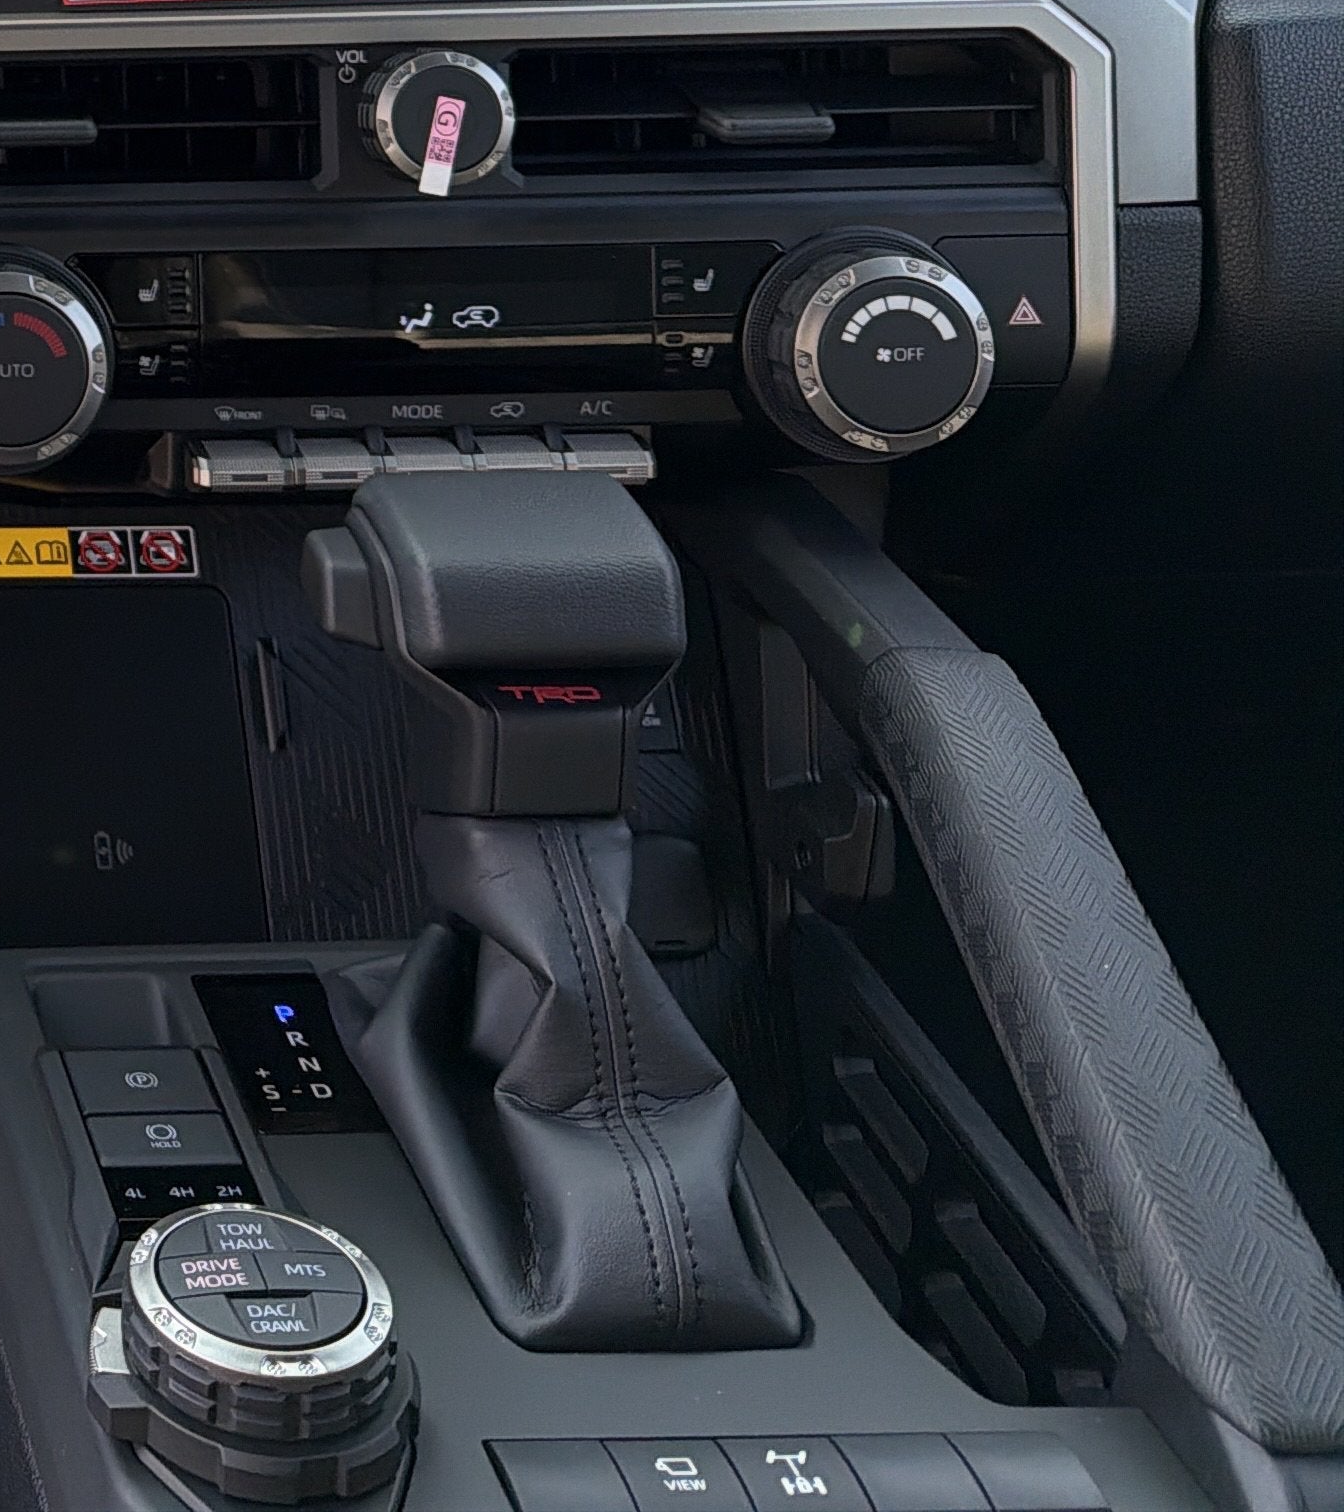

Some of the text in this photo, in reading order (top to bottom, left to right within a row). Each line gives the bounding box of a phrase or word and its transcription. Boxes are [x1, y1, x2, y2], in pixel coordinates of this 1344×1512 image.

[336, 50, 368, 64] VOL
[893, 347, 926, 362] OFF
[234, 410, 263, 420] FRONT
[392, 404, 444, 419] MODE
[580, 400, 612, 416] A/C
[497, 685, 601, 704] TRD
[273, 1005, 295, 1024] P
[285, 1031, 310, 1047] R
[297, 1056, 322, 1072] N
[262, 1083, 333, 1100] S D
[150, 1140, 182, 1149] HOLD
[124, 1185, 243, 1199] 4L 4H 2H
[216, 1223, 263, 1236] TOW
[219, 1238, 275, 1251] HAUL
[180, 1257, 242, 1275] DRIVE
[284, 1264, 327, 1277] MTS
[185, 1272, 250, 1290] MODE
[246, 1303, 296, 1318] DAC/
[250, 1319, 310, 1334] CRAWL
[662, 1478, 707, 1492] VIEW
